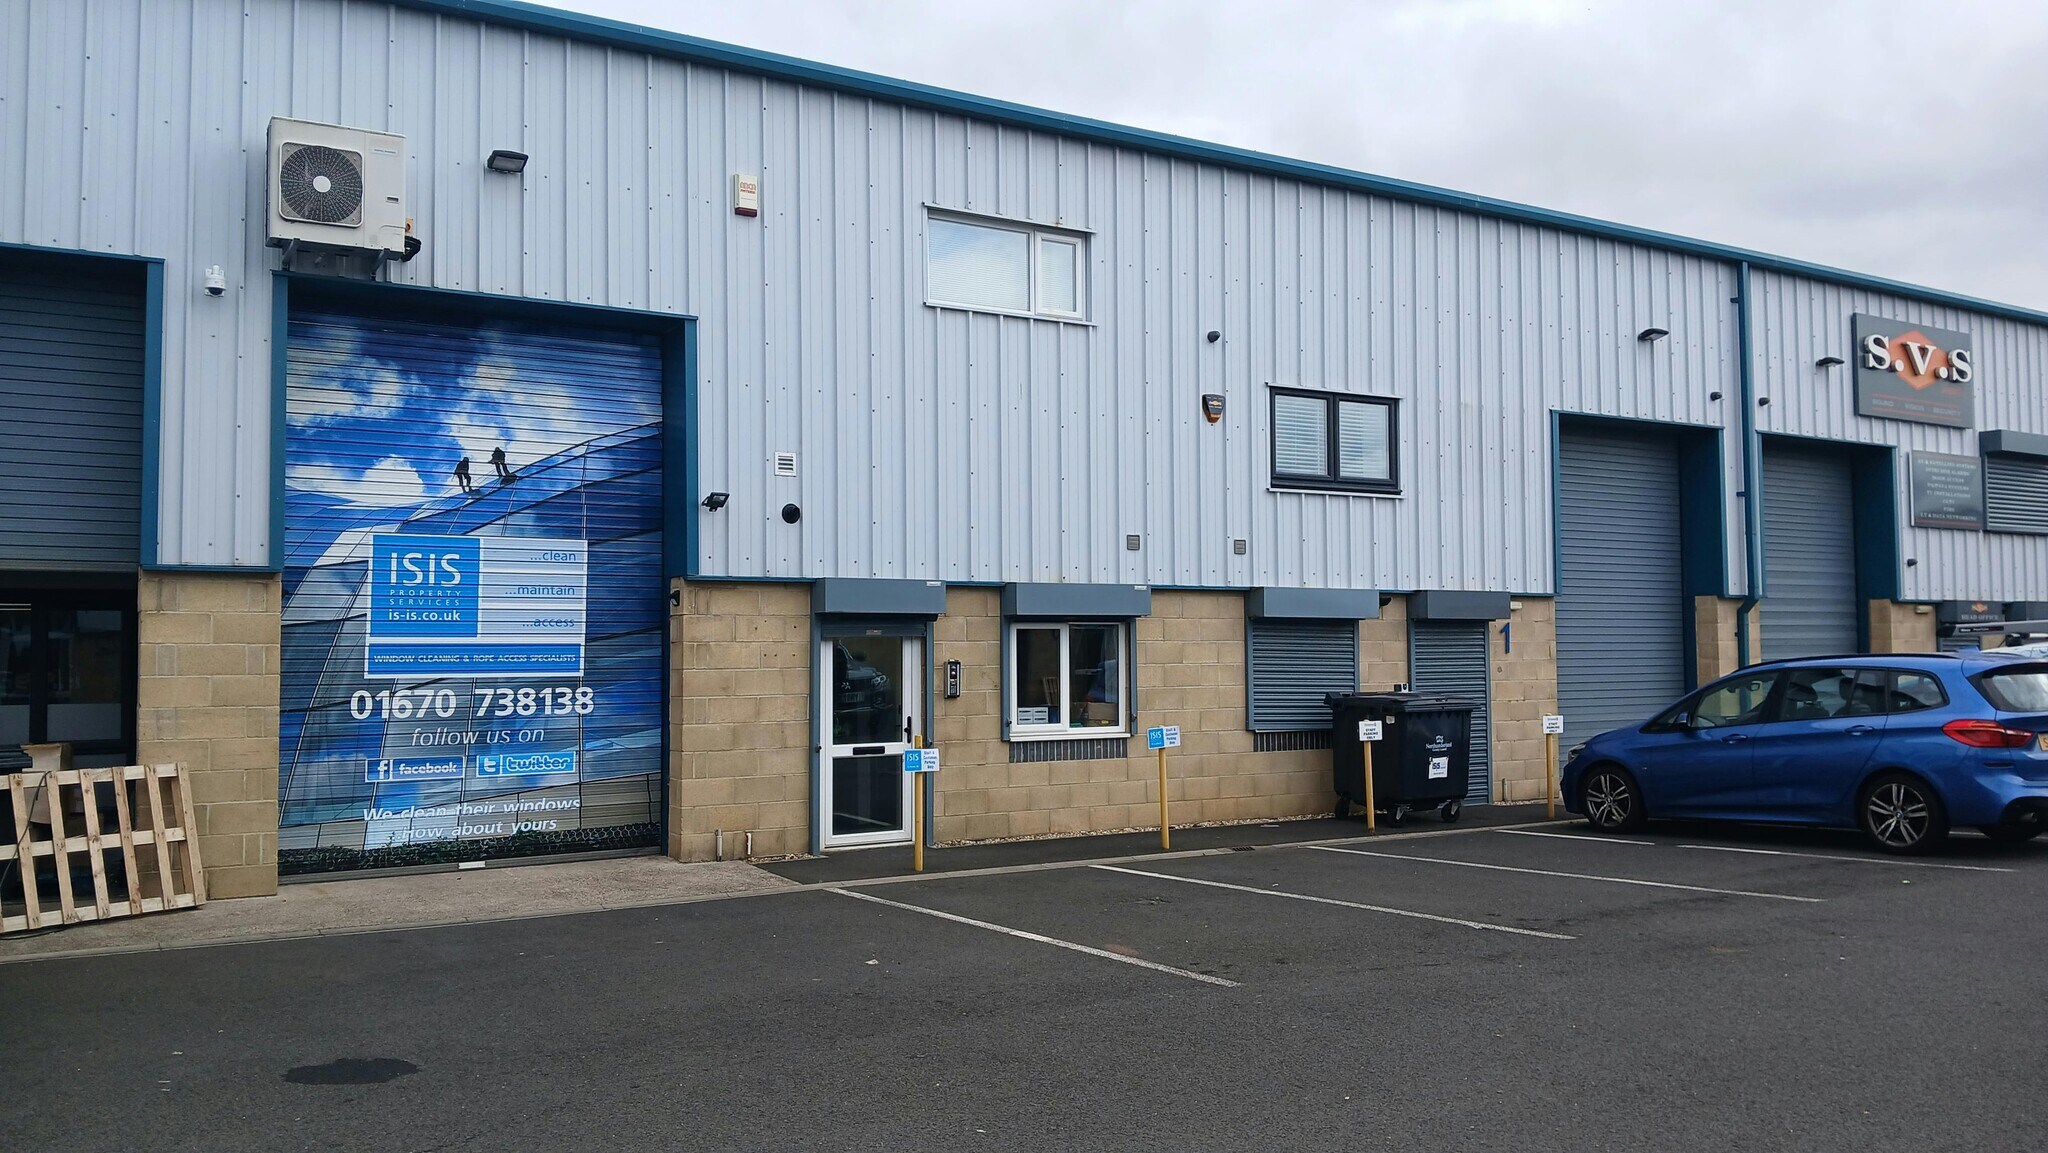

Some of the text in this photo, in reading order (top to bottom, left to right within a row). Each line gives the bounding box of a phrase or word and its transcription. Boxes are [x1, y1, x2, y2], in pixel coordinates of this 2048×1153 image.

[1864, 334, 1972, 383] S.V.S
[390, 552, 461, 587] ISIS
[389, 598, 460, 606] SERVICES
[390, 589, 461, 597] PROPERTY
[388, 609, 461, 621] is-is.co.uk
[1500, 622, 1510, 654] 1
[374, 655, 415, 663] WINDOW
[417, 654, 460, 663] CLEANING
[473, 654, 495, 662] ROPE
[497, 654, 527, 662] ACCESS
[529, 654, 576, 662] SPECIALISTS
[350, 687, 595, 720] 01670 738138
[411, 728, 545, 746] follow us on
[399, 762, 458, 775] facebook
[506, 755, 572, 771] twitter
[363, 796, 581, 821] We clean their windows
[451, 821, 503, 836] about
